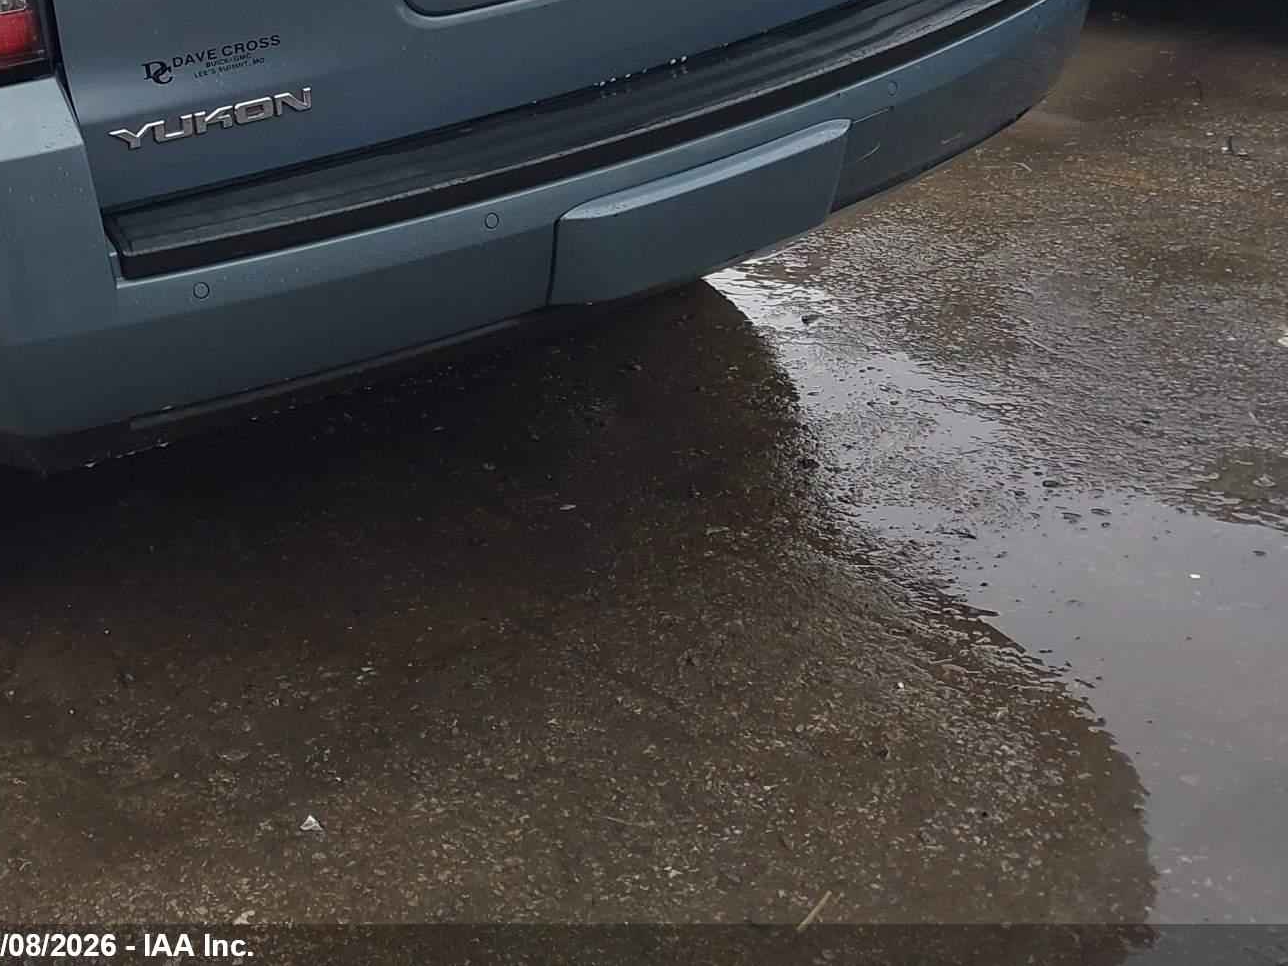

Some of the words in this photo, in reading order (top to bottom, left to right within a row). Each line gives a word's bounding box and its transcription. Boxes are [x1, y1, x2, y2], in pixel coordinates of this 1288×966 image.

[172, 49, 218, 68] DAVE
[222, 34, 281, 57] CROSS
[109, 87, 312, 150] YUKON
